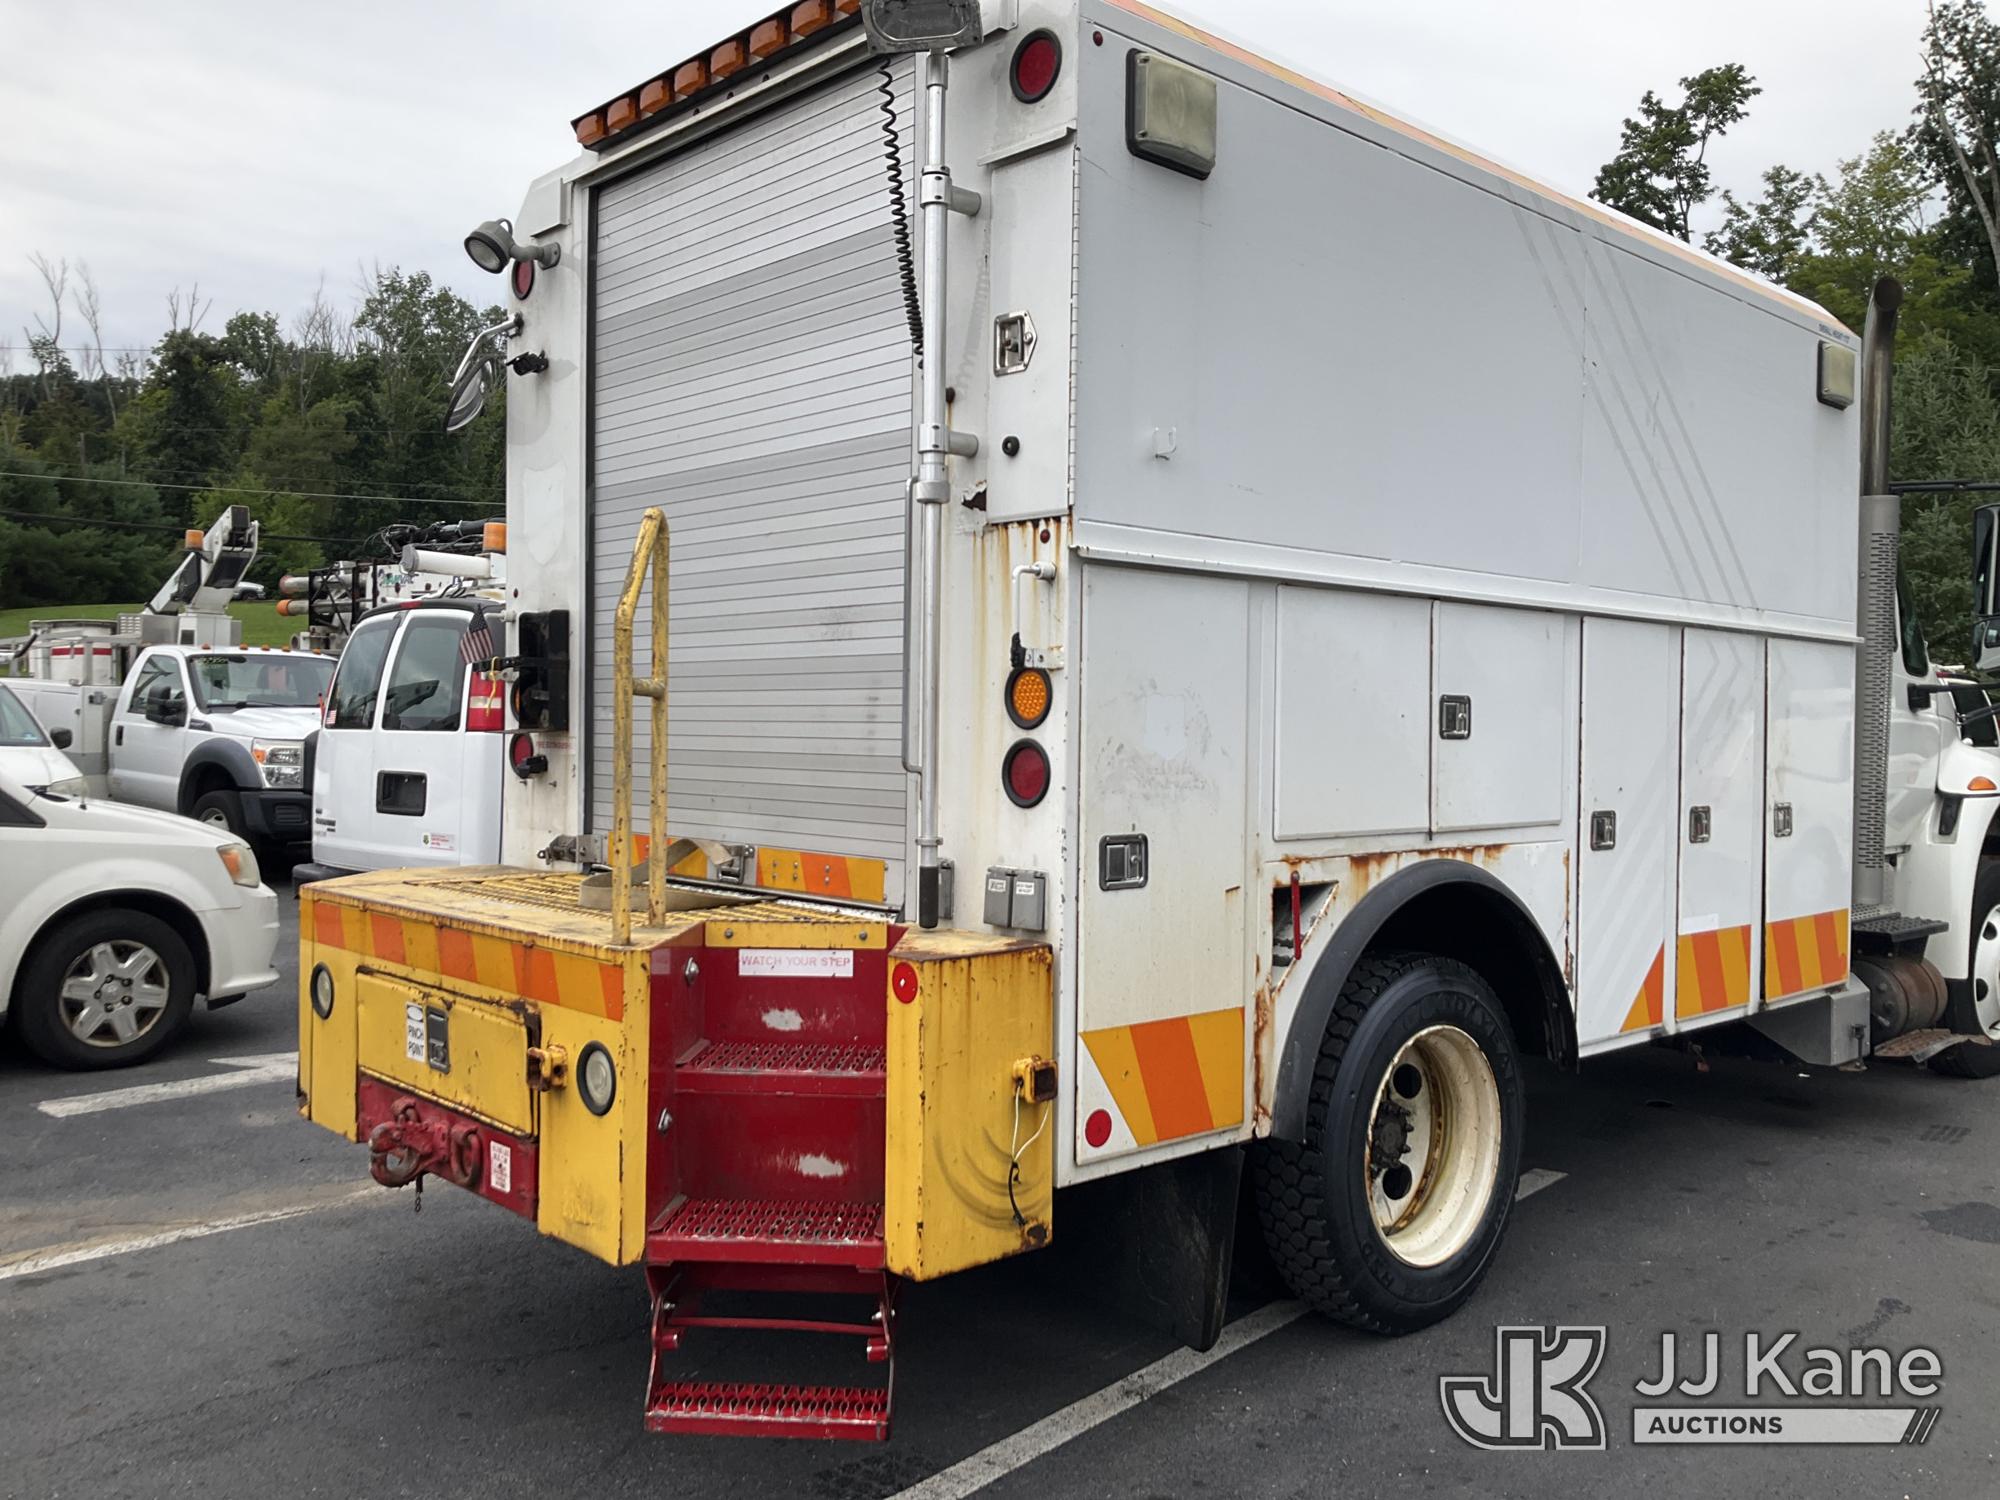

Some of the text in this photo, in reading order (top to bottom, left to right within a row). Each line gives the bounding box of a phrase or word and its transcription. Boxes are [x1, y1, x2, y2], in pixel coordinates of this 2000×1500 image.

[741, 955, 851, 967] WATCH YOUR STEP
